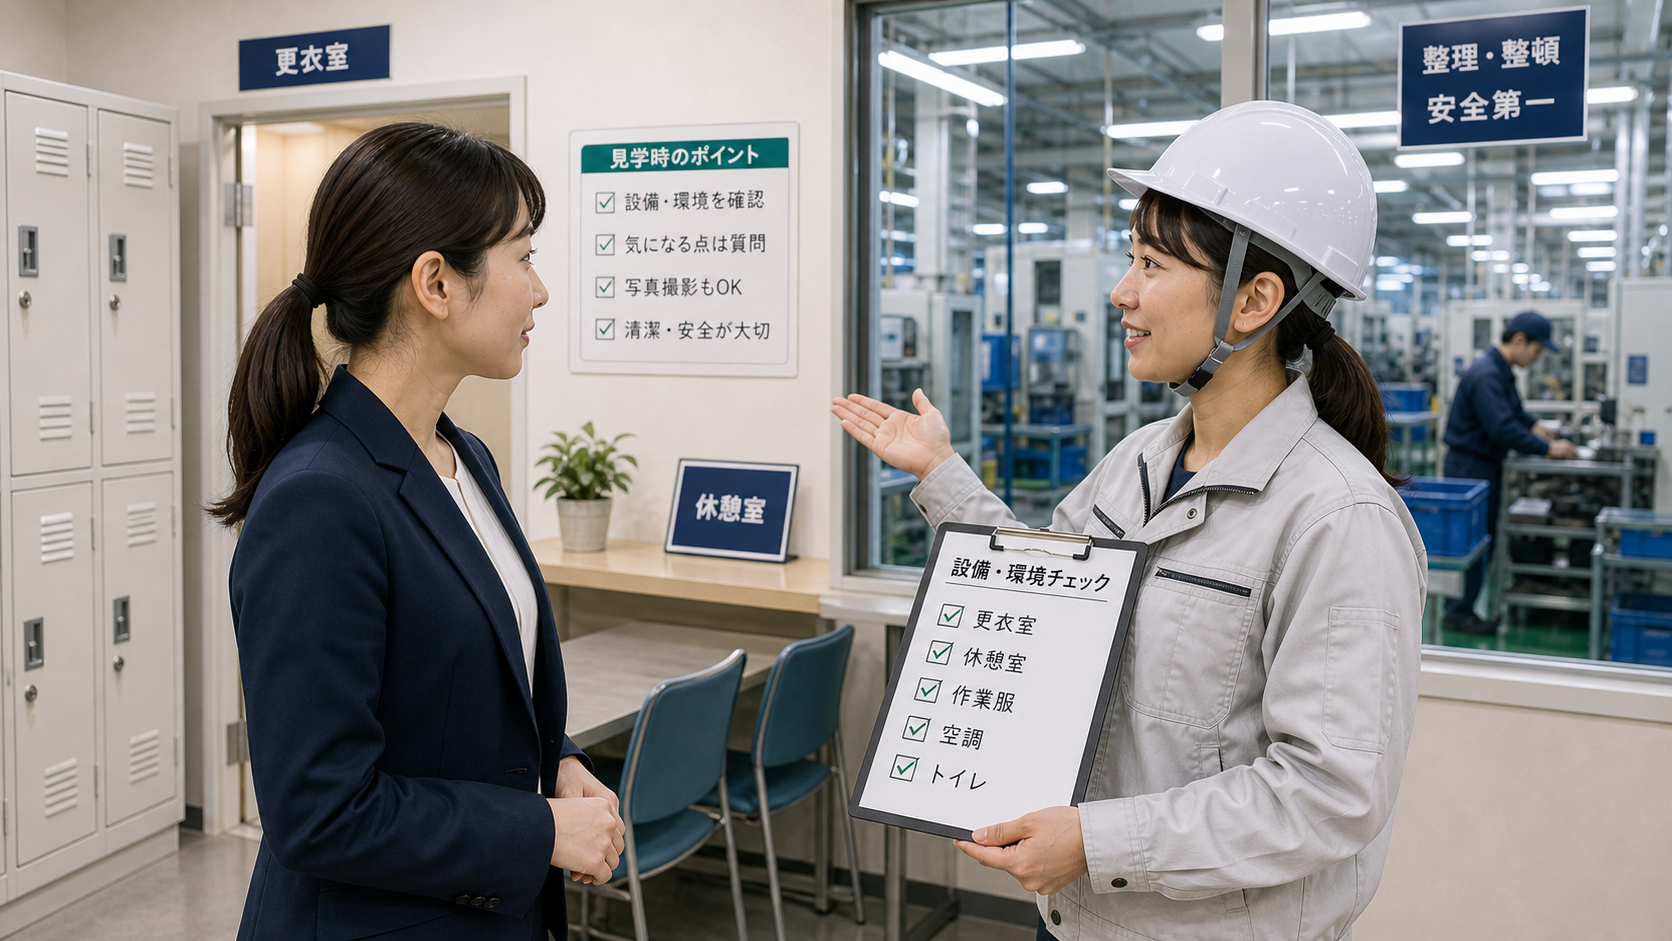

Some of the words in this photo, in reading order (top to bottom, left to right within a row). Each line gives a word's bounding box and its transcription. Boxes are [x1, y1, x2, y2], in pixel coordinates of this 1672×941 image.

[275, 42, 349, 76] 更衣室
[1423, 36, 1560, 74] 整理・整頓
[1428, 90, 1554, 124] 安全第一
[610, 144, 760, 169] 見学時のポイント
[625, 190, 764, 211] 設備・環境を確認
[626, 234, 765, 254] 気になる点は質問
[626, 278, 742, 296] 写真撮影もOK
[625, 320, 769, 340] 清潔・安全が大切
[696, 493, 767, 525] 休憩室
[951, 557, 1110, 592] 設備・環境チェック
[973, 609, 1037, 636] 更衣室
[963, 647, 1027, 674] 休憩室
[952, 684, 1016, 714] 作業服
[940, 724, 984, 751] 空調
[931, 764, 987, 791] トイレ
